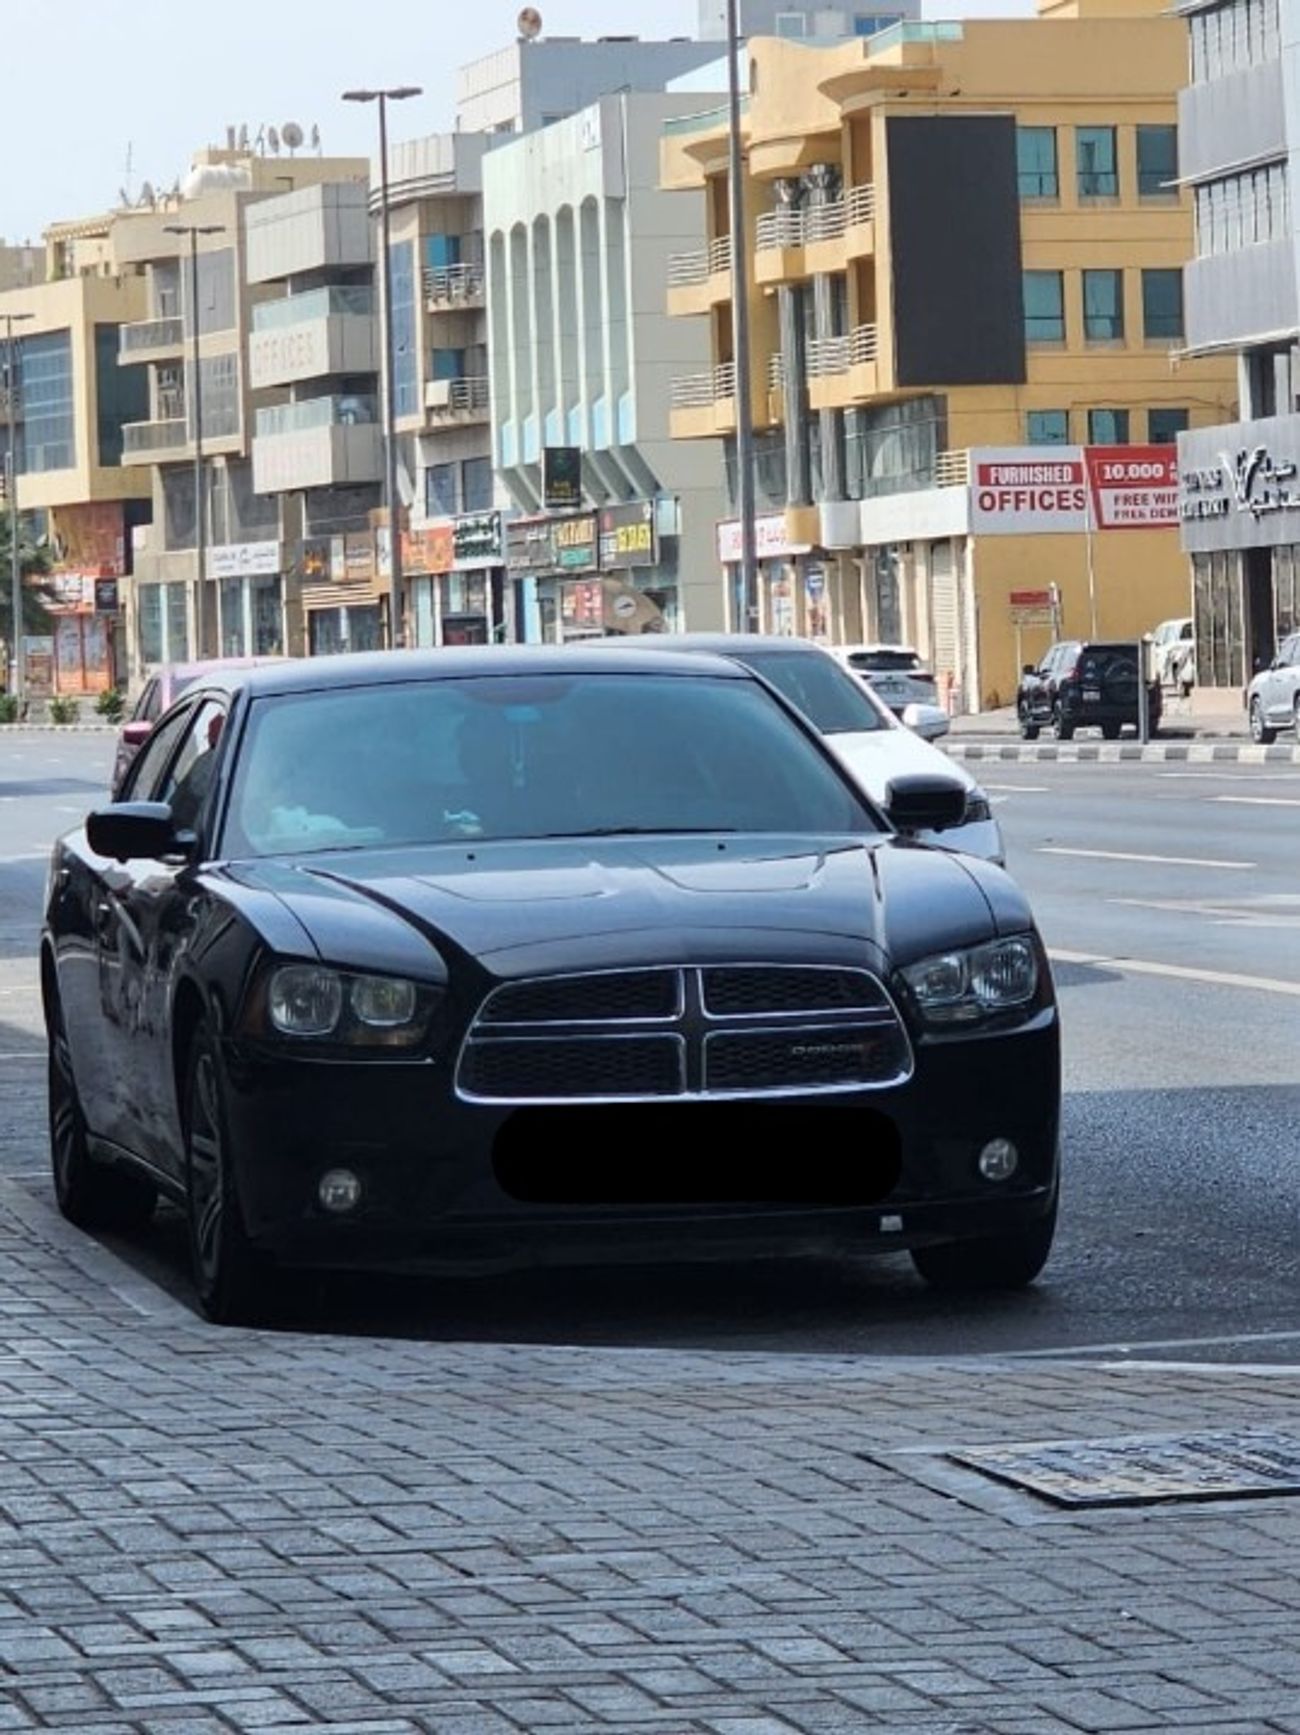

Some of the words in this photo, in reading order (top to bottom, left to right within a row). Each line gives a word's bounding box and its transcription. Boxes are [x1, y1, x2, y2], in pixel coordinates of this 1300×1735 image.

[990, 465, 1073, 485] FURNISHED
[979, 488, 1086, 512] OFFICES
[1114, 492, 1149, 506] FREE
